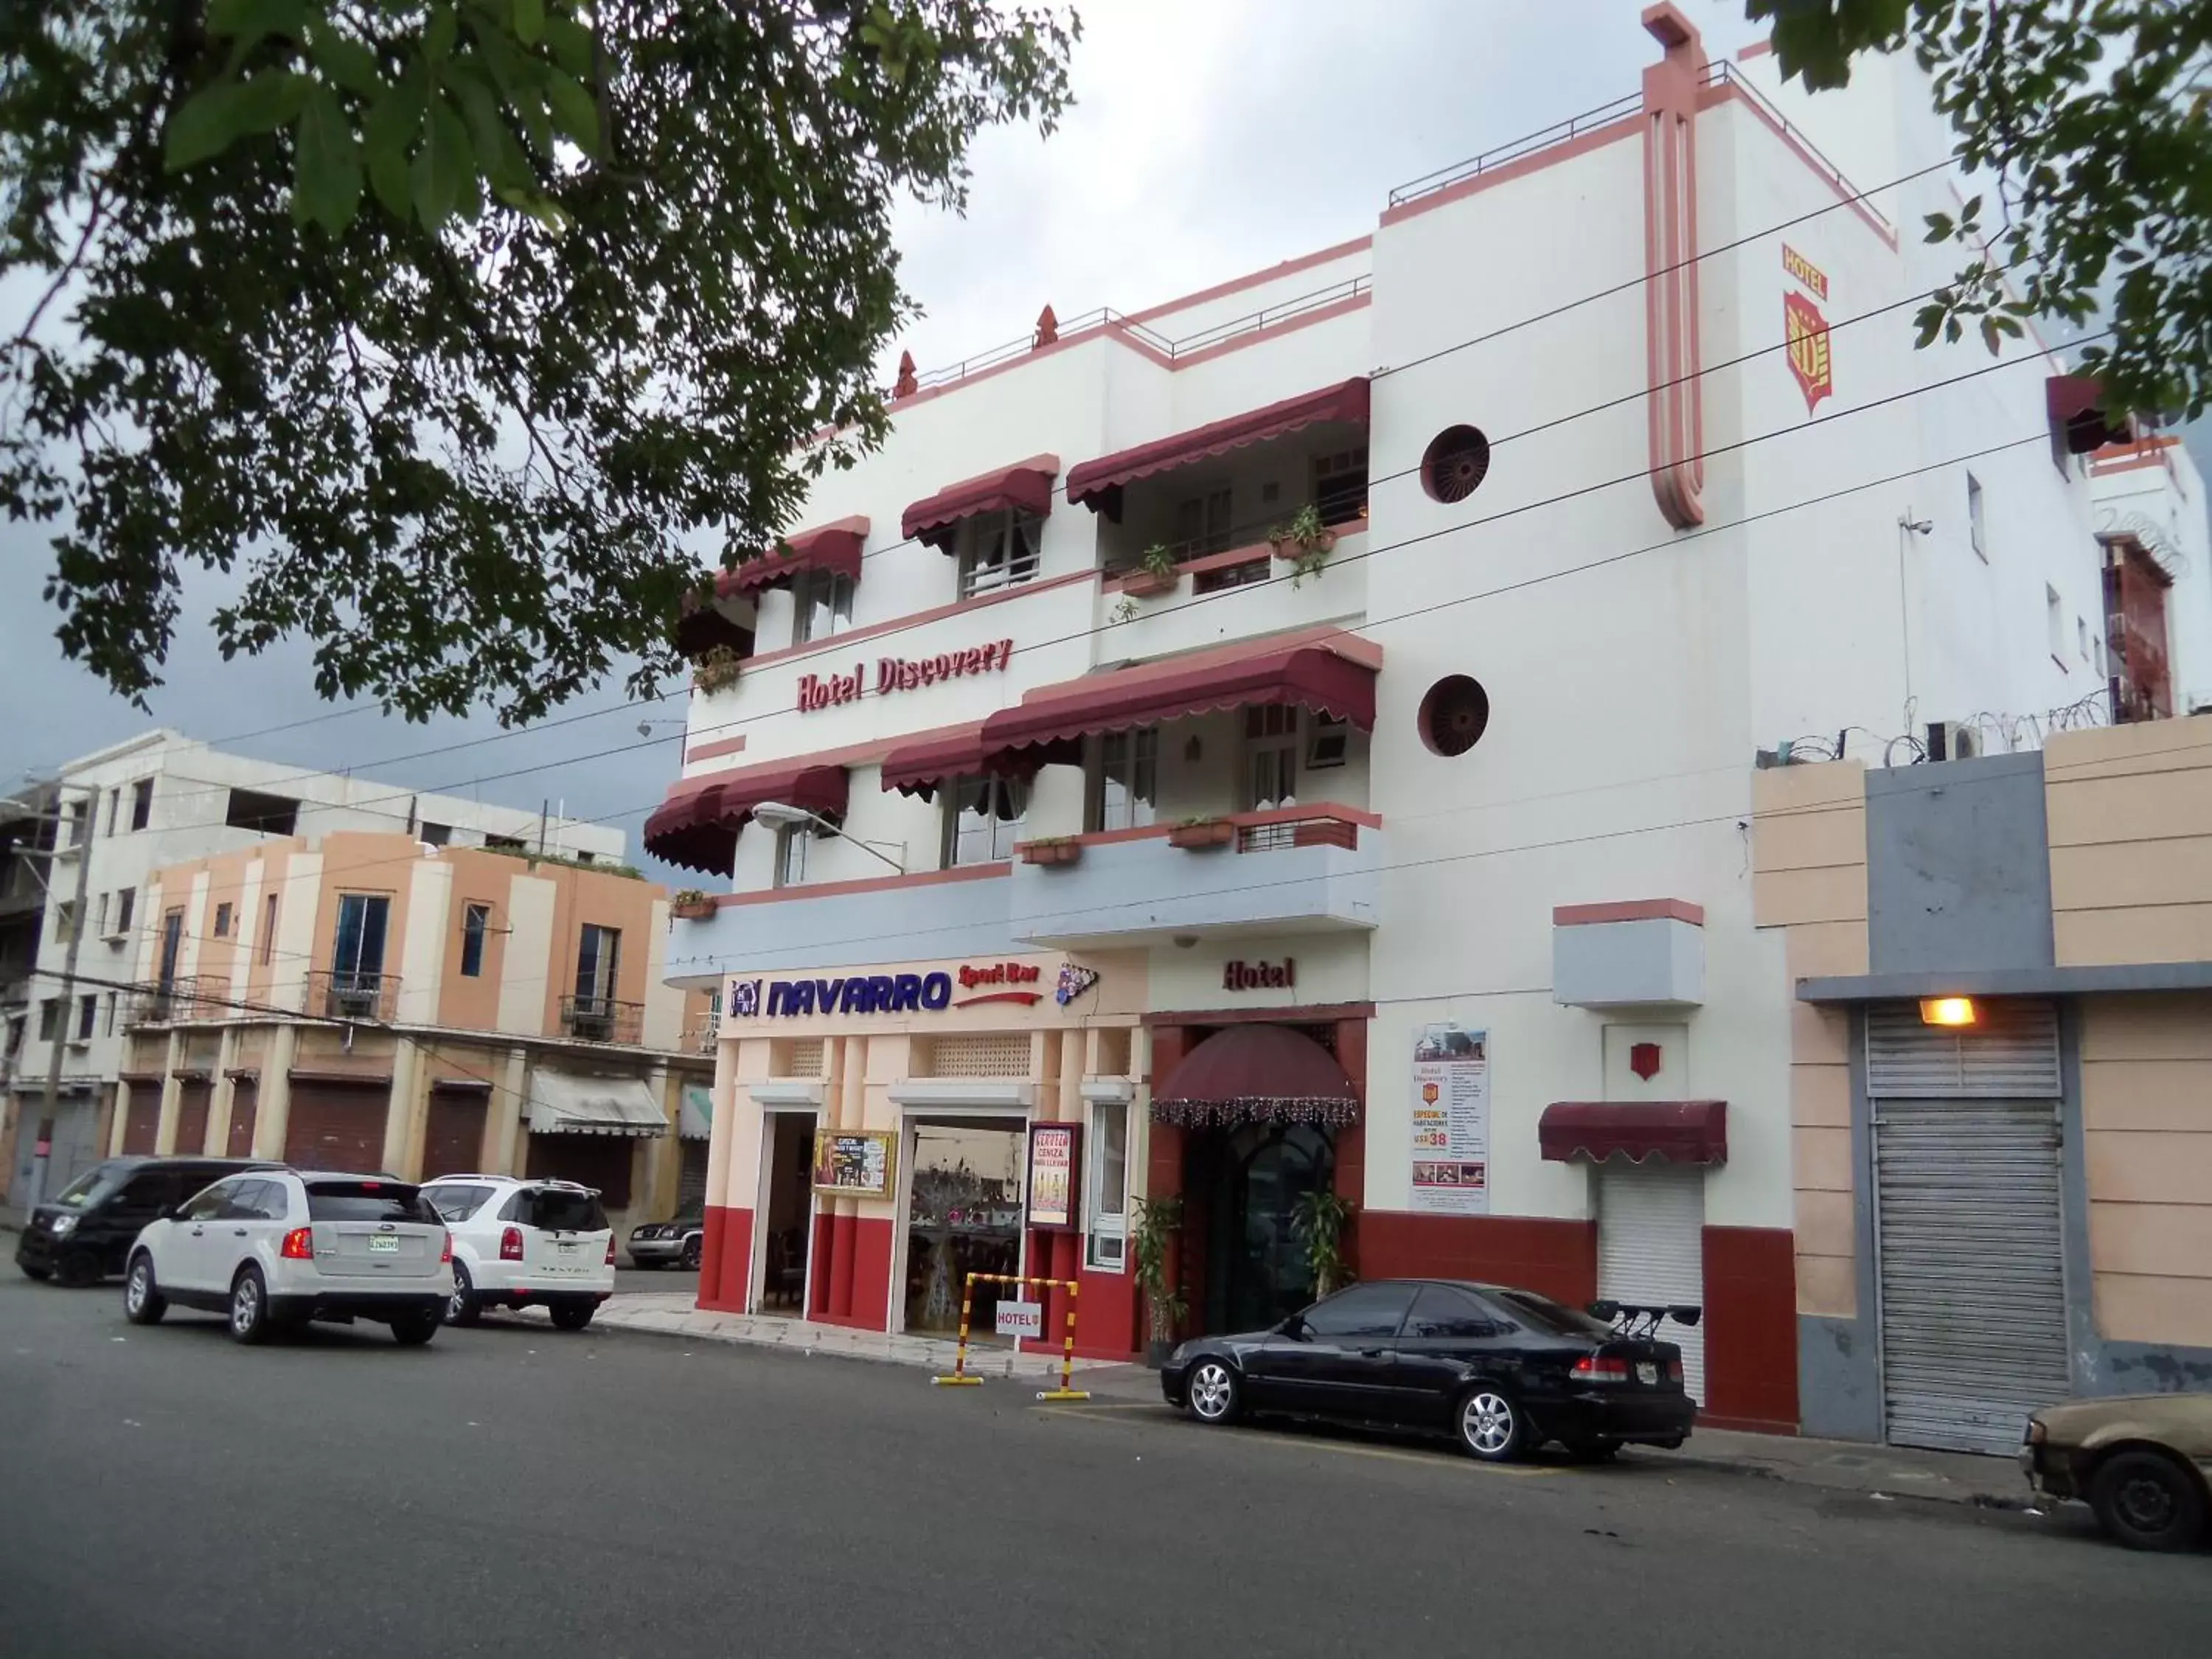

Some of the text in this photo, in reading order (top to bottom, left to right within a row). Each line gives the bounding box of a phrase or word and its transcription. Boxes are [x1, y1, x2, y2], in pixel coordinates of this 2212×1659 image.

[1784, 246, 1826, 297] HOTEL
[797, 639, 1014, 713] Hotel Discovery
[1006, 963, 1040, 983] Bar
[1222, 956, 1295, 991] Hotel
[767, 971, 952, 1017] NAVARRO
[1430, 1133, 1447, 1146] 38
[998, 1312, 1032, 1326] HOTEL
